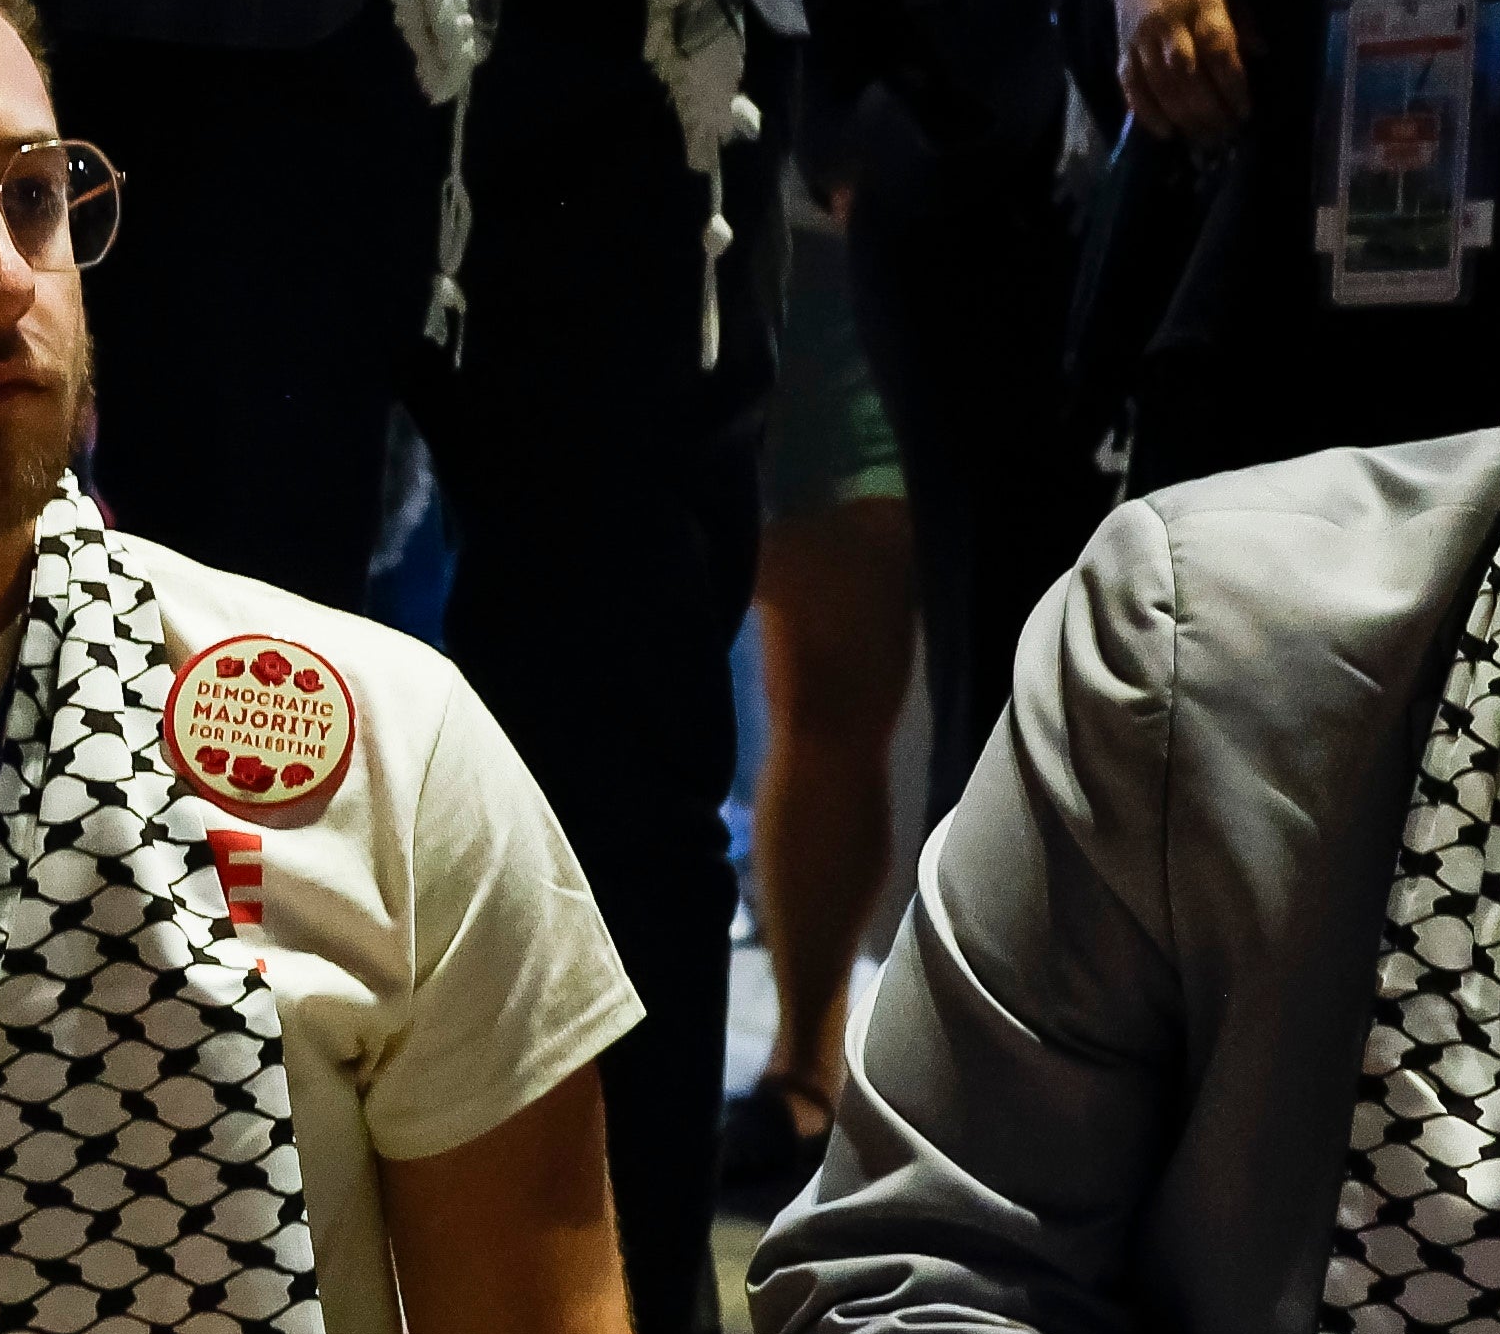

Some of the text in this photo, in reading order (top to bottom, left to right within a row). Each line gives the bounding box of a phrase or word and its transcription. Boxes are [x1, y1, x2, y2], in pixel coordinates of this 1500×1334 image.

[197, 681, 333, 717] DEMOCRATIC
[193, 701, 332, 740] MAJORITY
[190, 723, 326, 759] FOR PALESTINE
